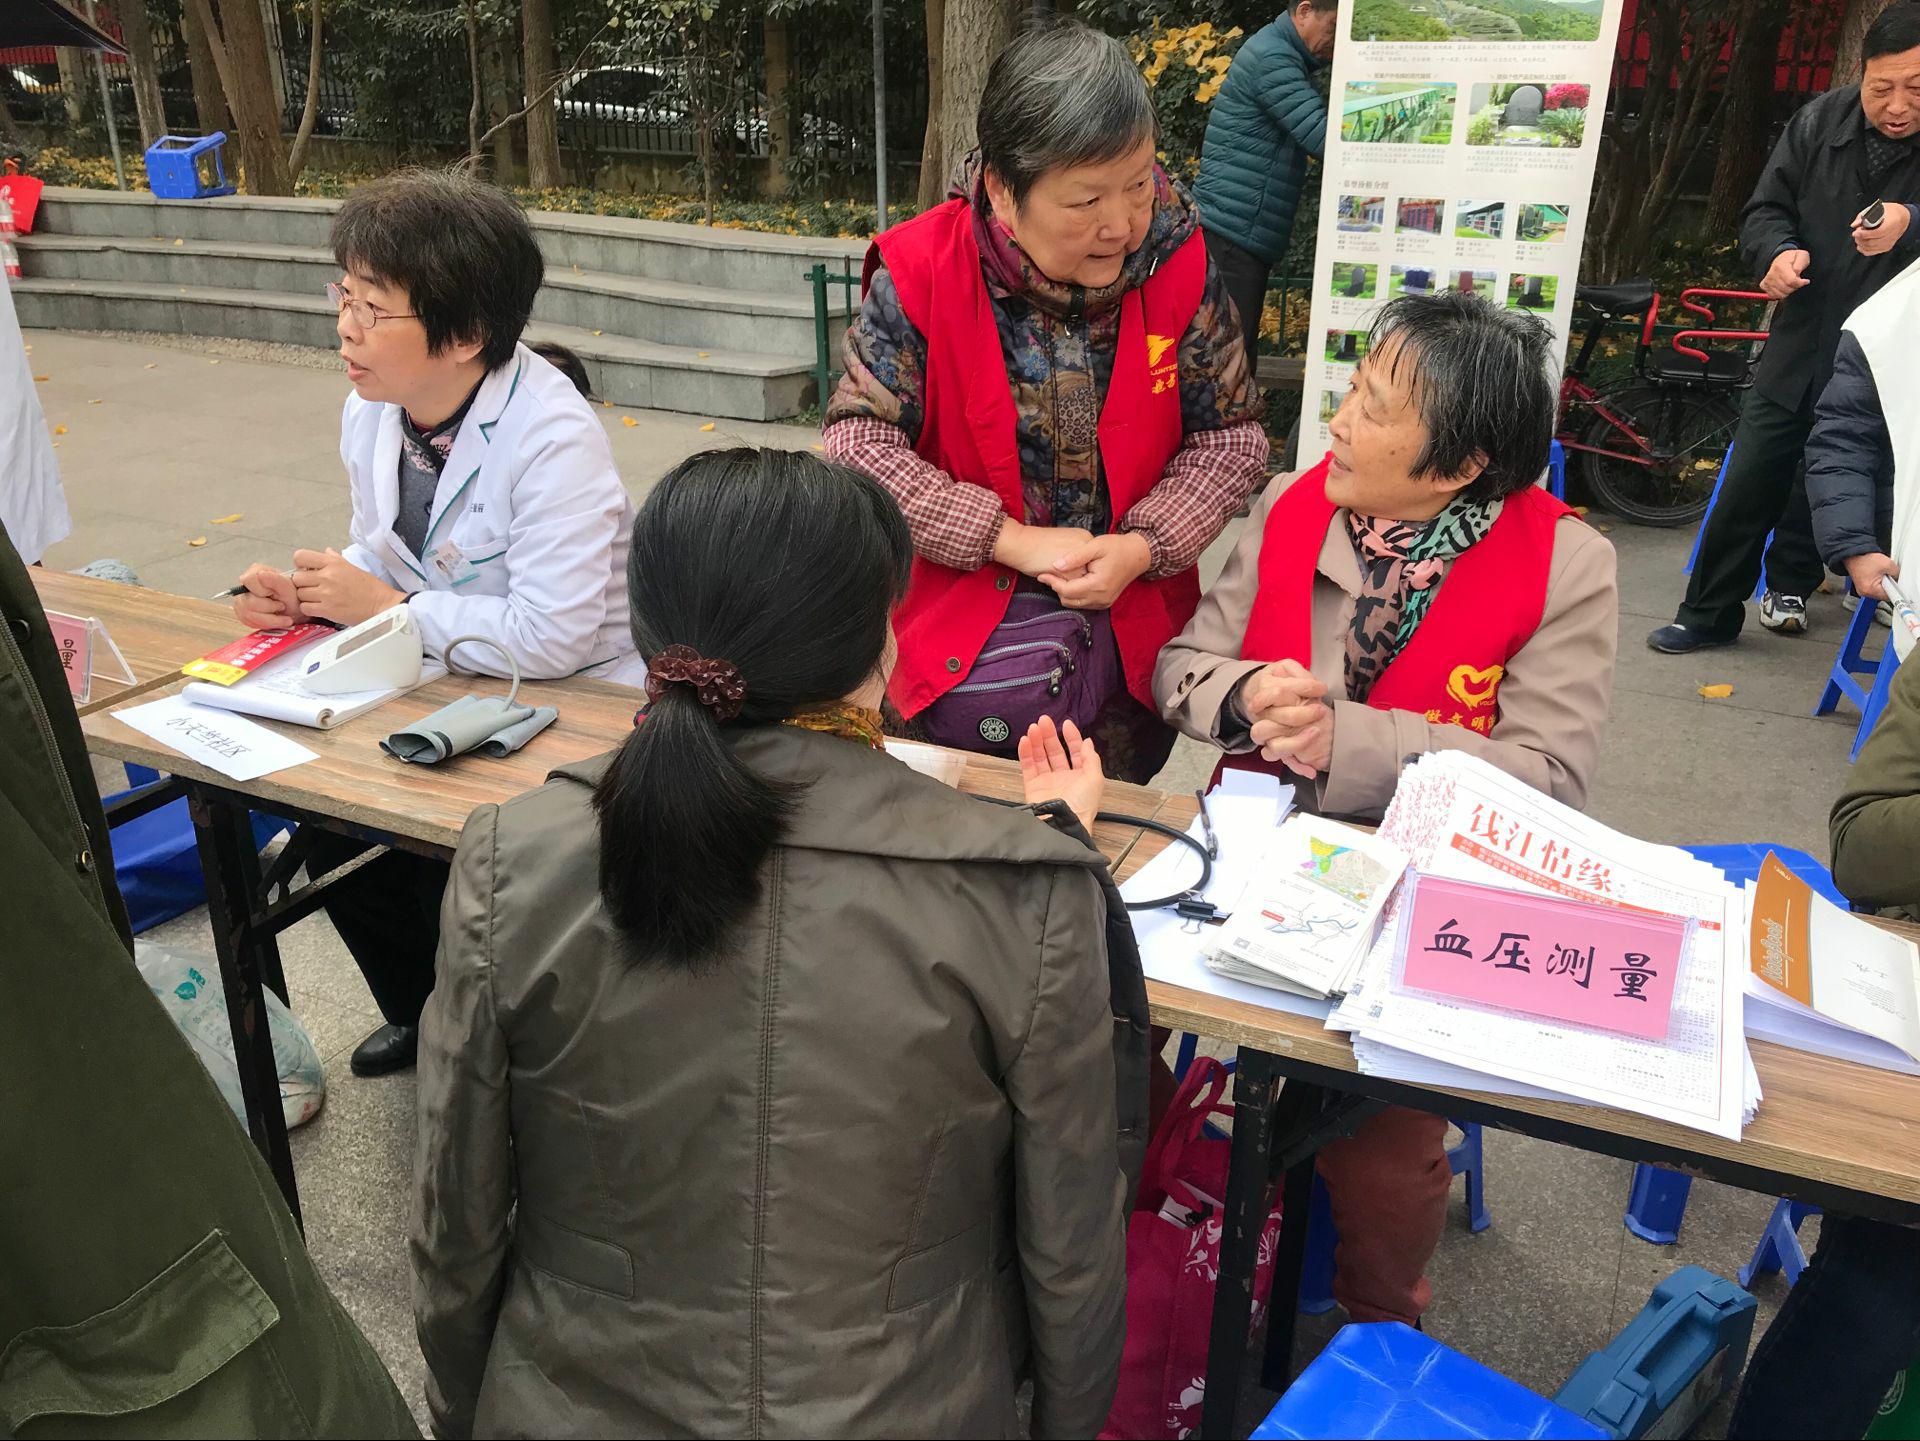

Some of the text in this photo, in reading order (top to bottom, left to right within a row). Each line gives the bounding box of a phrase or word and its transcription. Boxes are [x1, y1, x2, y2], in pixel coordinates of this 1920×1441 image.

[58, 638, 78, 671] 量
[1423, 918, 1658, 1002] 血压测量
